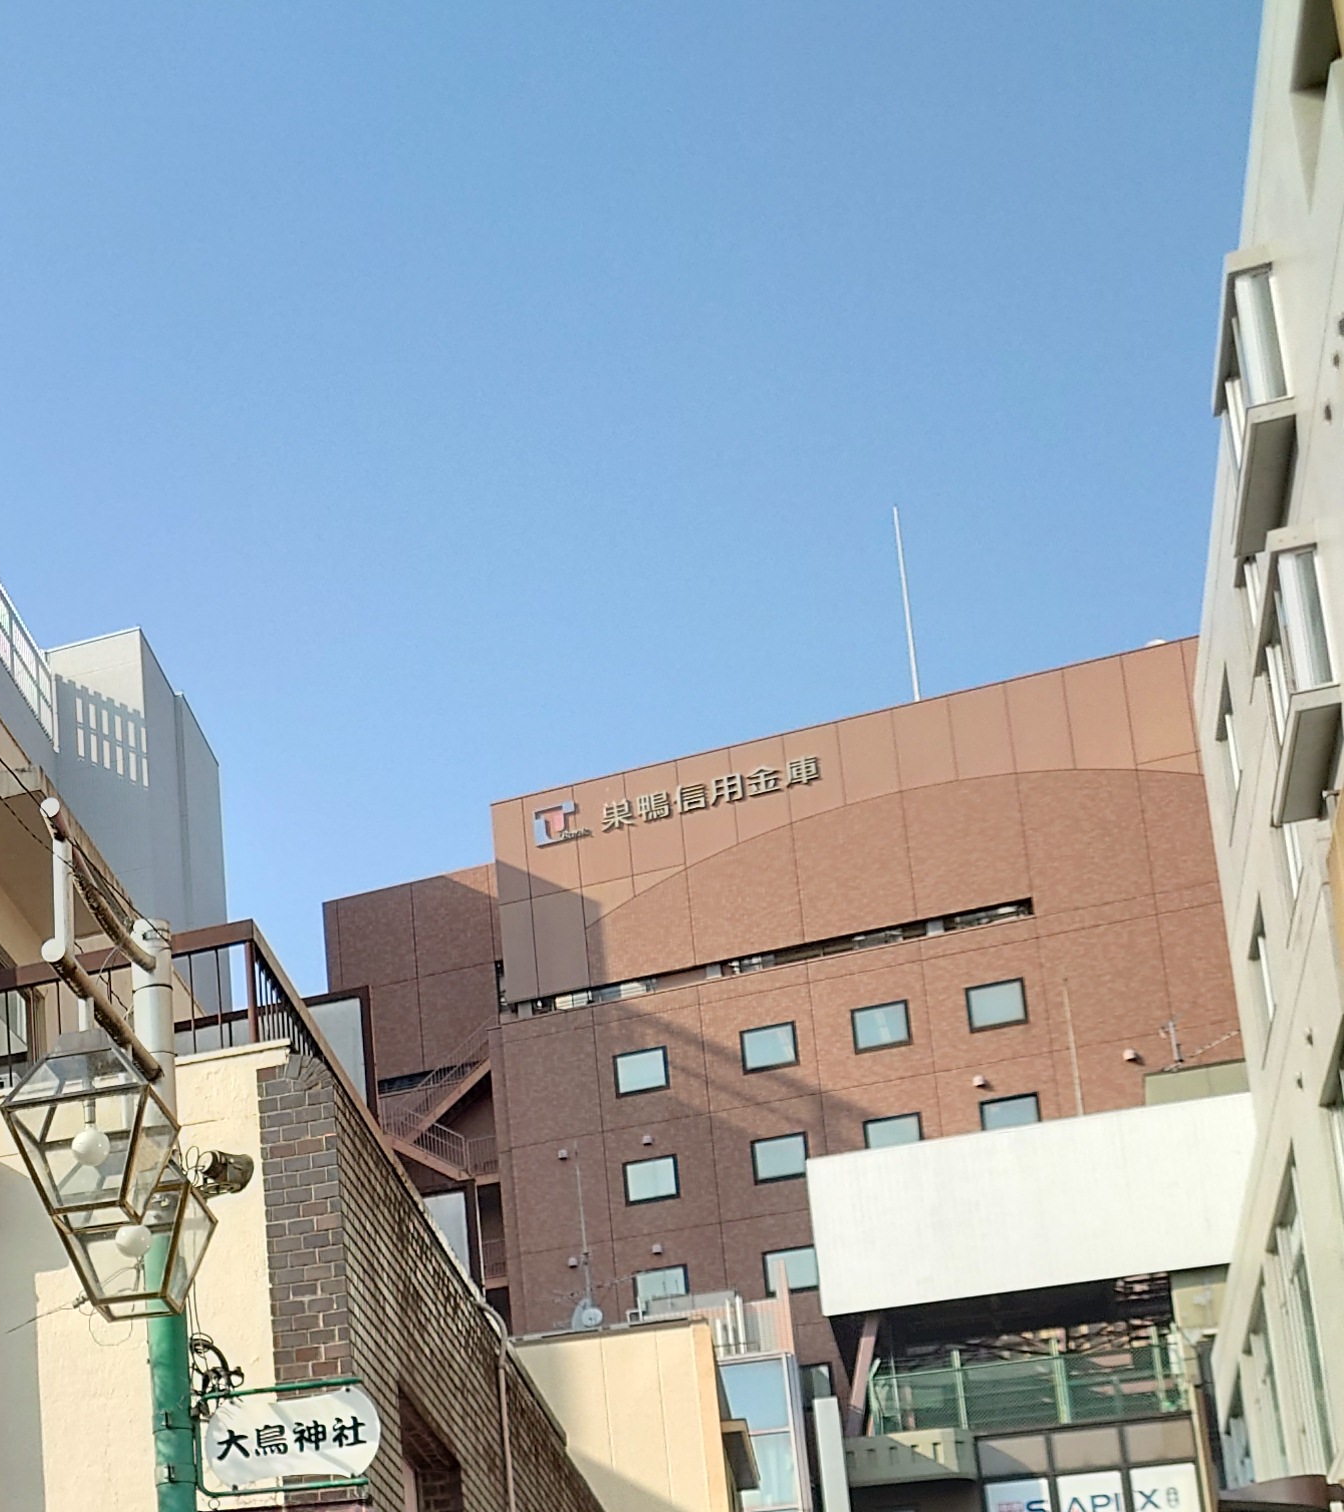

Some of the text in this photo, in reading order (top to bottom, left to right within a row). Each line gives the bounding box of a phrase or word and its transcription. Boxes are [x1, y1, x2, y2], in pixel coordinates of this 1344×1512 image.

[600, 753, 822, 832] 巣鴨信用金庫
[216, 1415, 368, 1462] 大鳥神社
